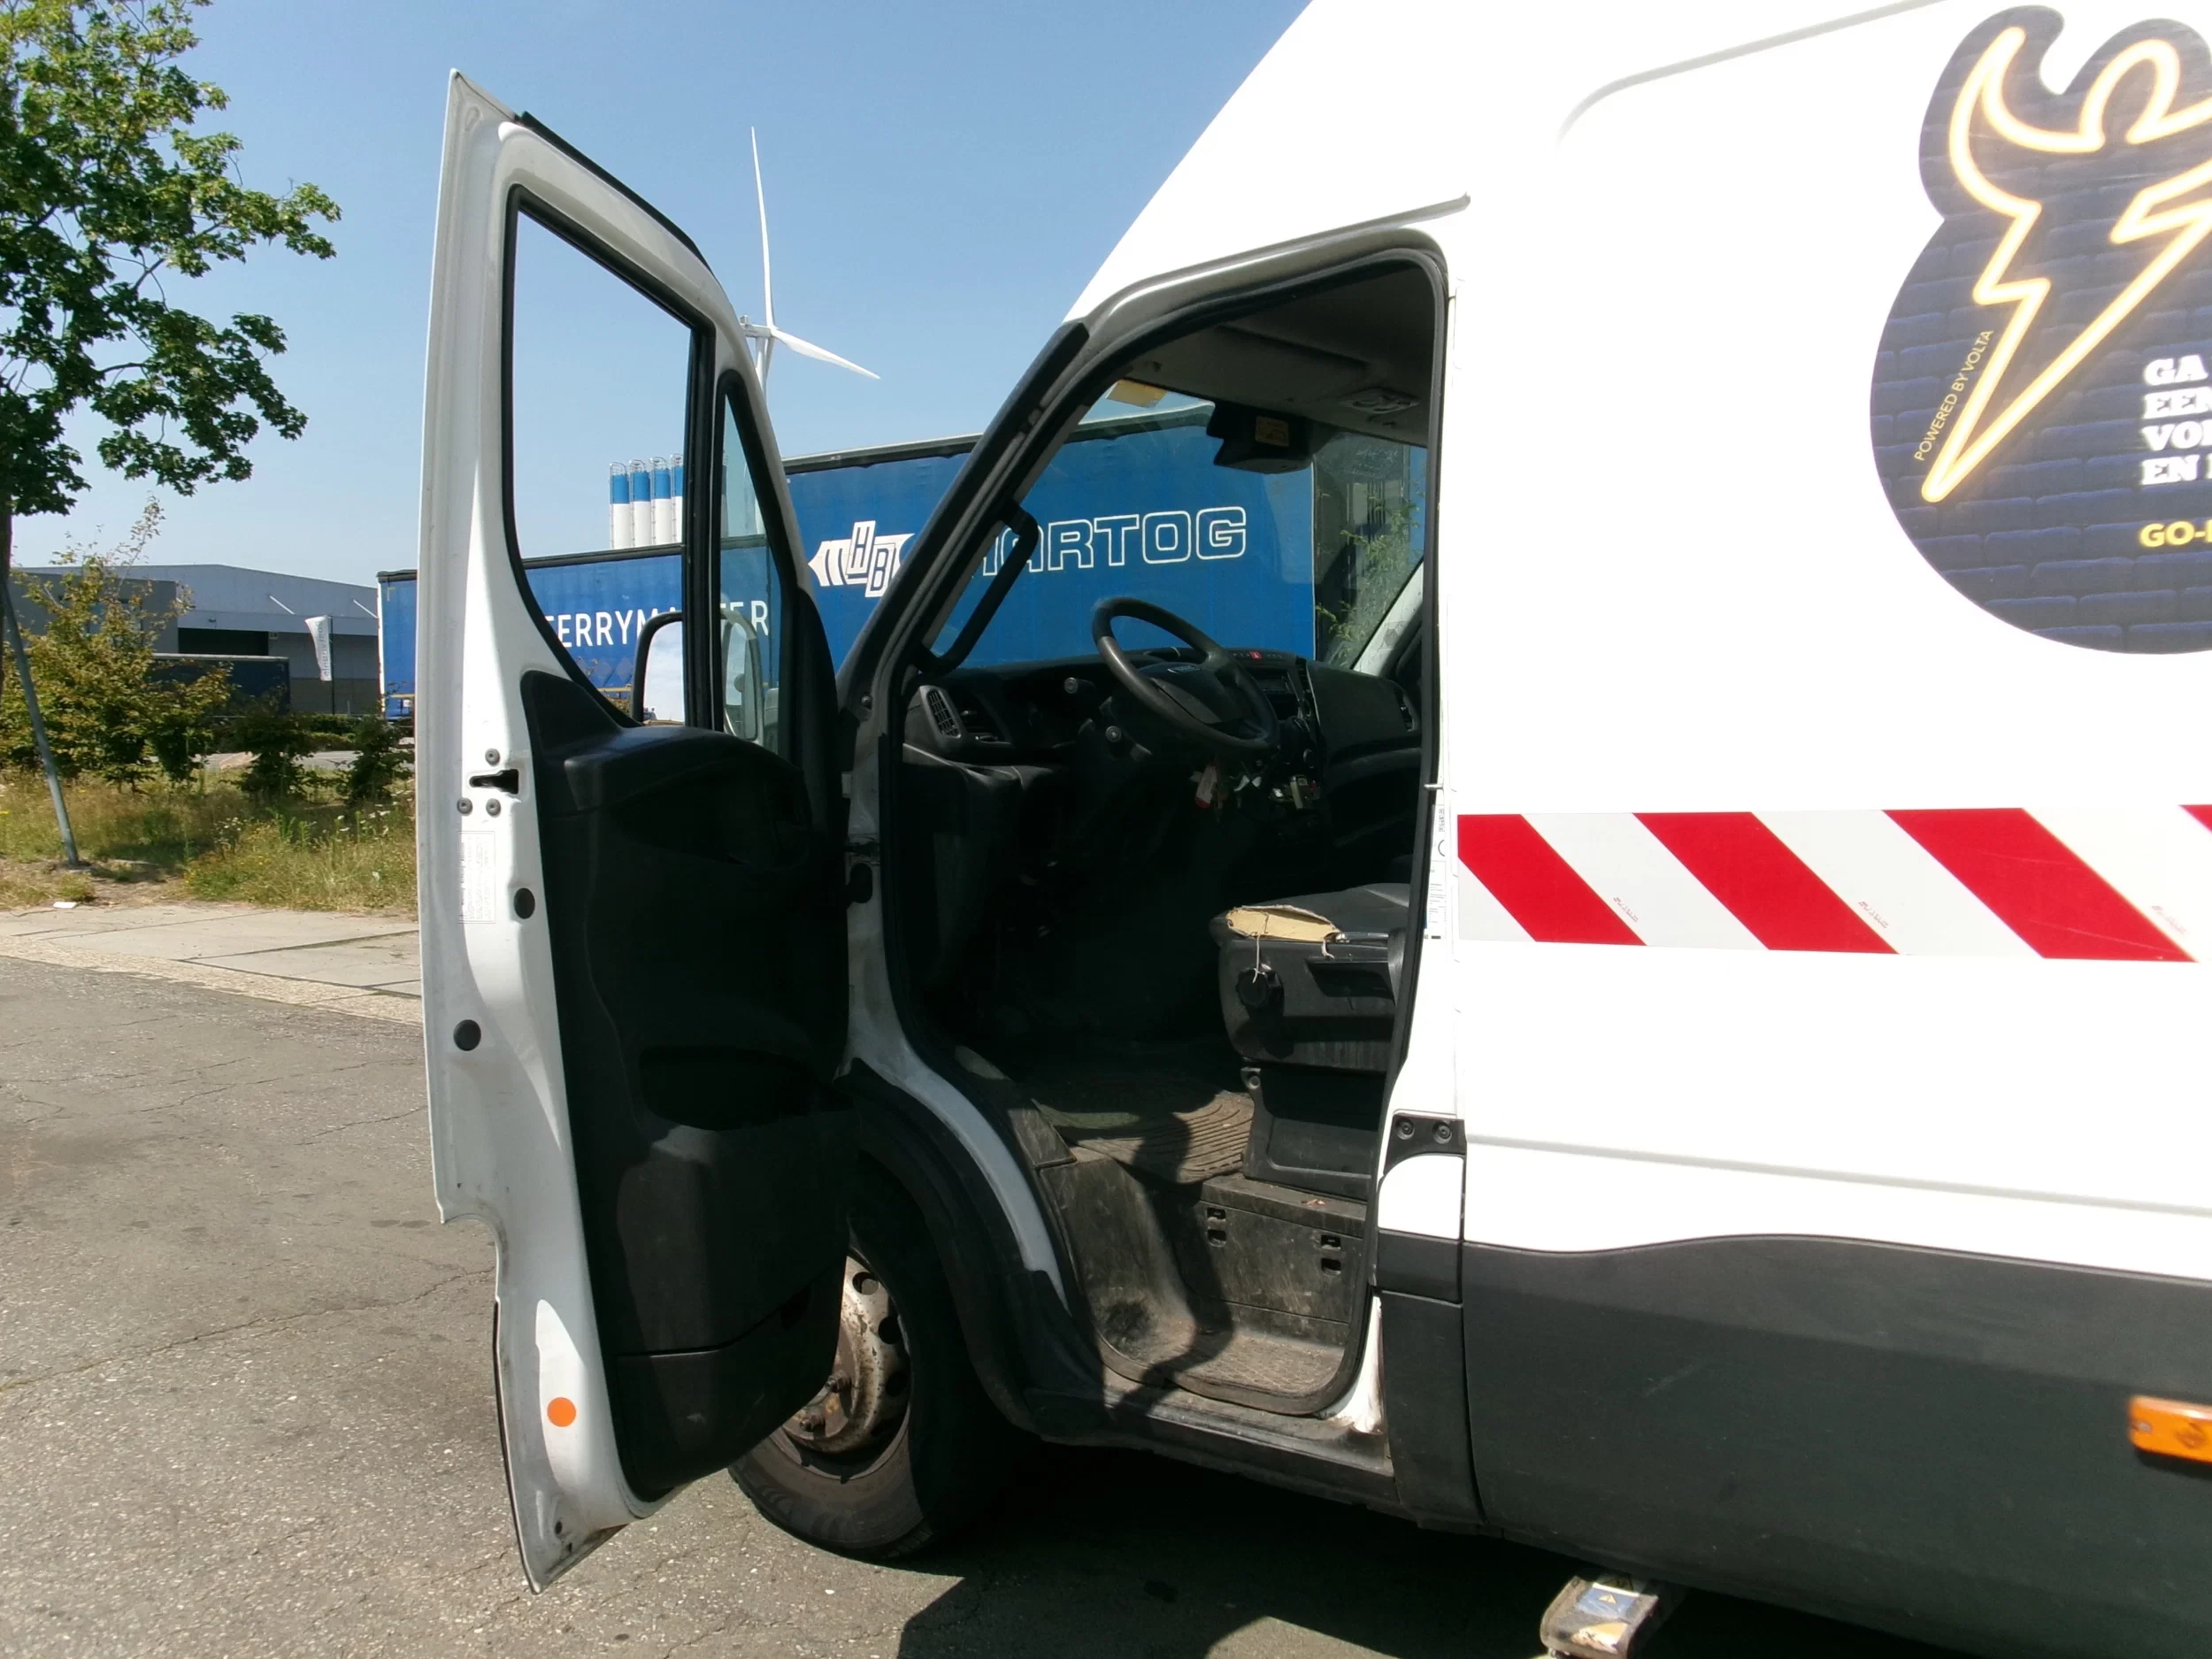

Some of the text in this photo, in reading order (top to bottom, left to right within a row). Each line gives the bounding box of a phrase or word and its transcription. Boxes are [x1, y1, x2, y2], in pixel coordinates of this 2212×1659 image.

[2145, 355, 2208, 386] GA
[1914, 330, 1994, 461] POWERED BY VOLTA
[2141, 455, 2200, 485] EN
[2140, 519, 2212, 548] GO-
